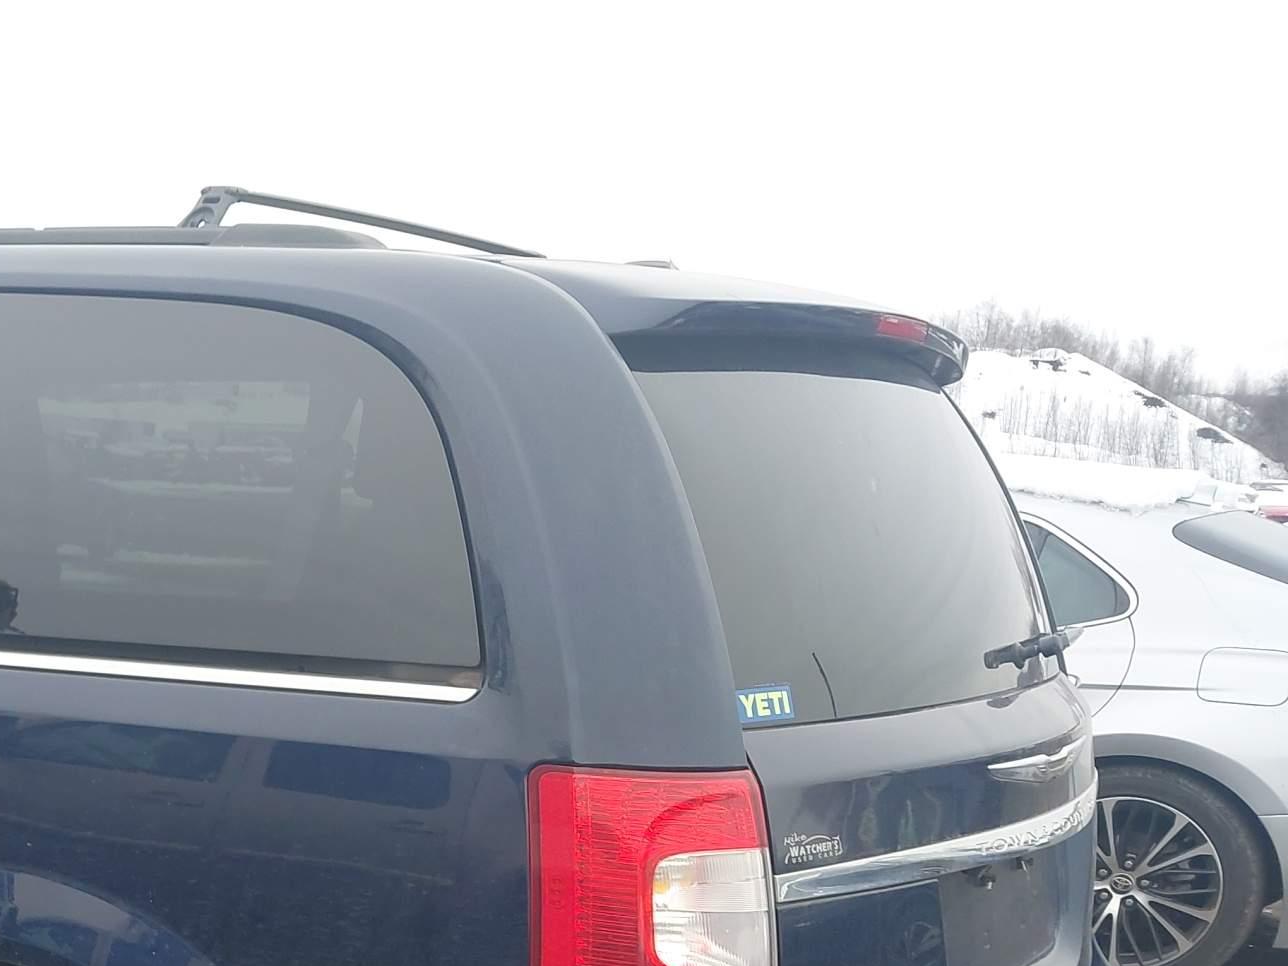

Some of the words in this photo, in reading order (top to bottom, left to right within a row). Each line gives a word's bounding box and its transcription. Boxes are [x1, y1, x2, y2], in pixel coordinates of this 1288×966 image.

[738, 690, 791, 718] YETI
[789, 840, 839, 858] WATCHER'S
[791, 855, 813, 863] USED
